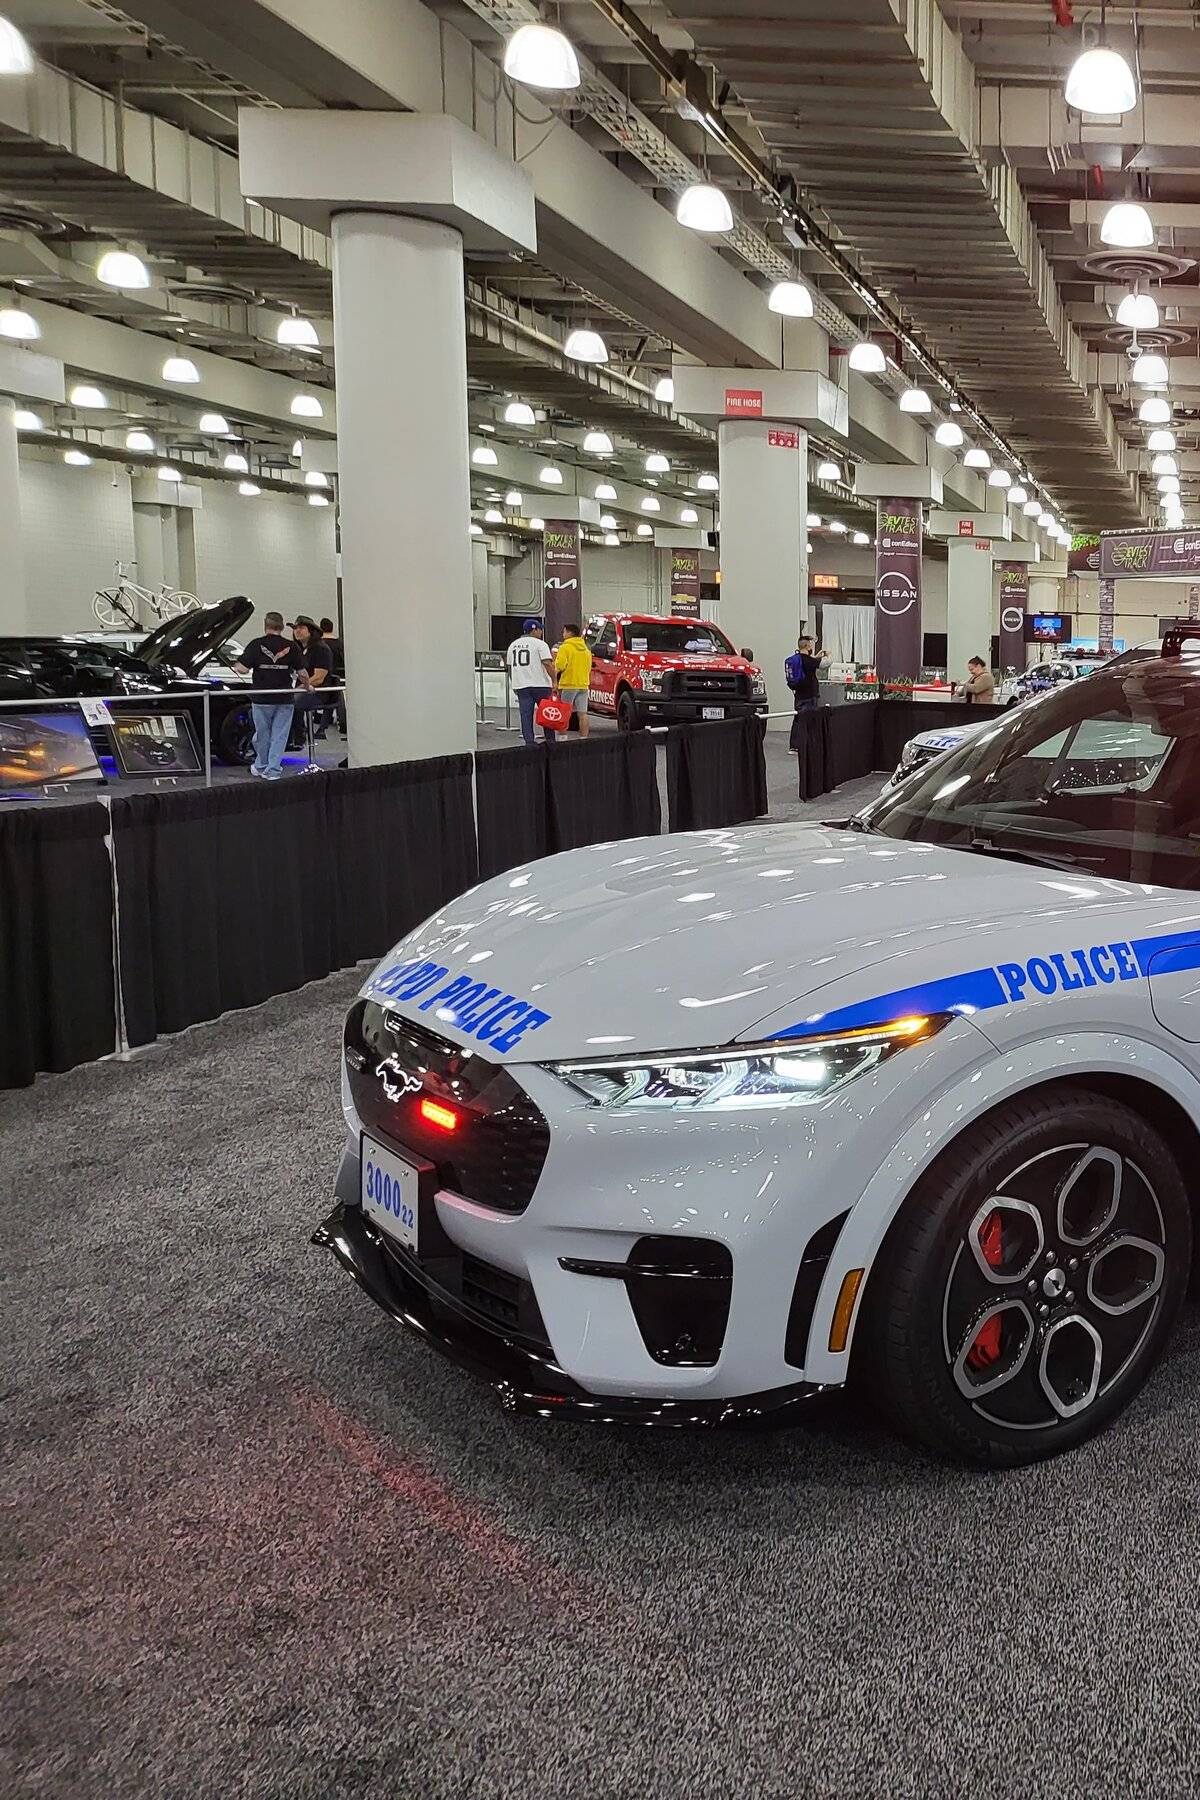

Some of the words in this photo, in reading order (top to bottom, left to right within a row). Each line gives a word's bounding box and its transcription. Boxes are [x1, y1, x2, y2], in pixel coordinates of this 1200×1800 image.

[727, 398, 742, 407] FIRE
[743, 399, 761, 408] HOSE
[886, 525, 916, 534] TRACK
[1124, 556, 1148, 569] TRACK
[877, 588, 917, 599] NISSAN
[512, 649, 531, 667] 10
[997, 943, 1138, 1002] POLICE
[418, 975, 552, 1054] POLICE
[366, 1161, 401, 1218] 3000
[402, 1204, 414, 1230] 22
